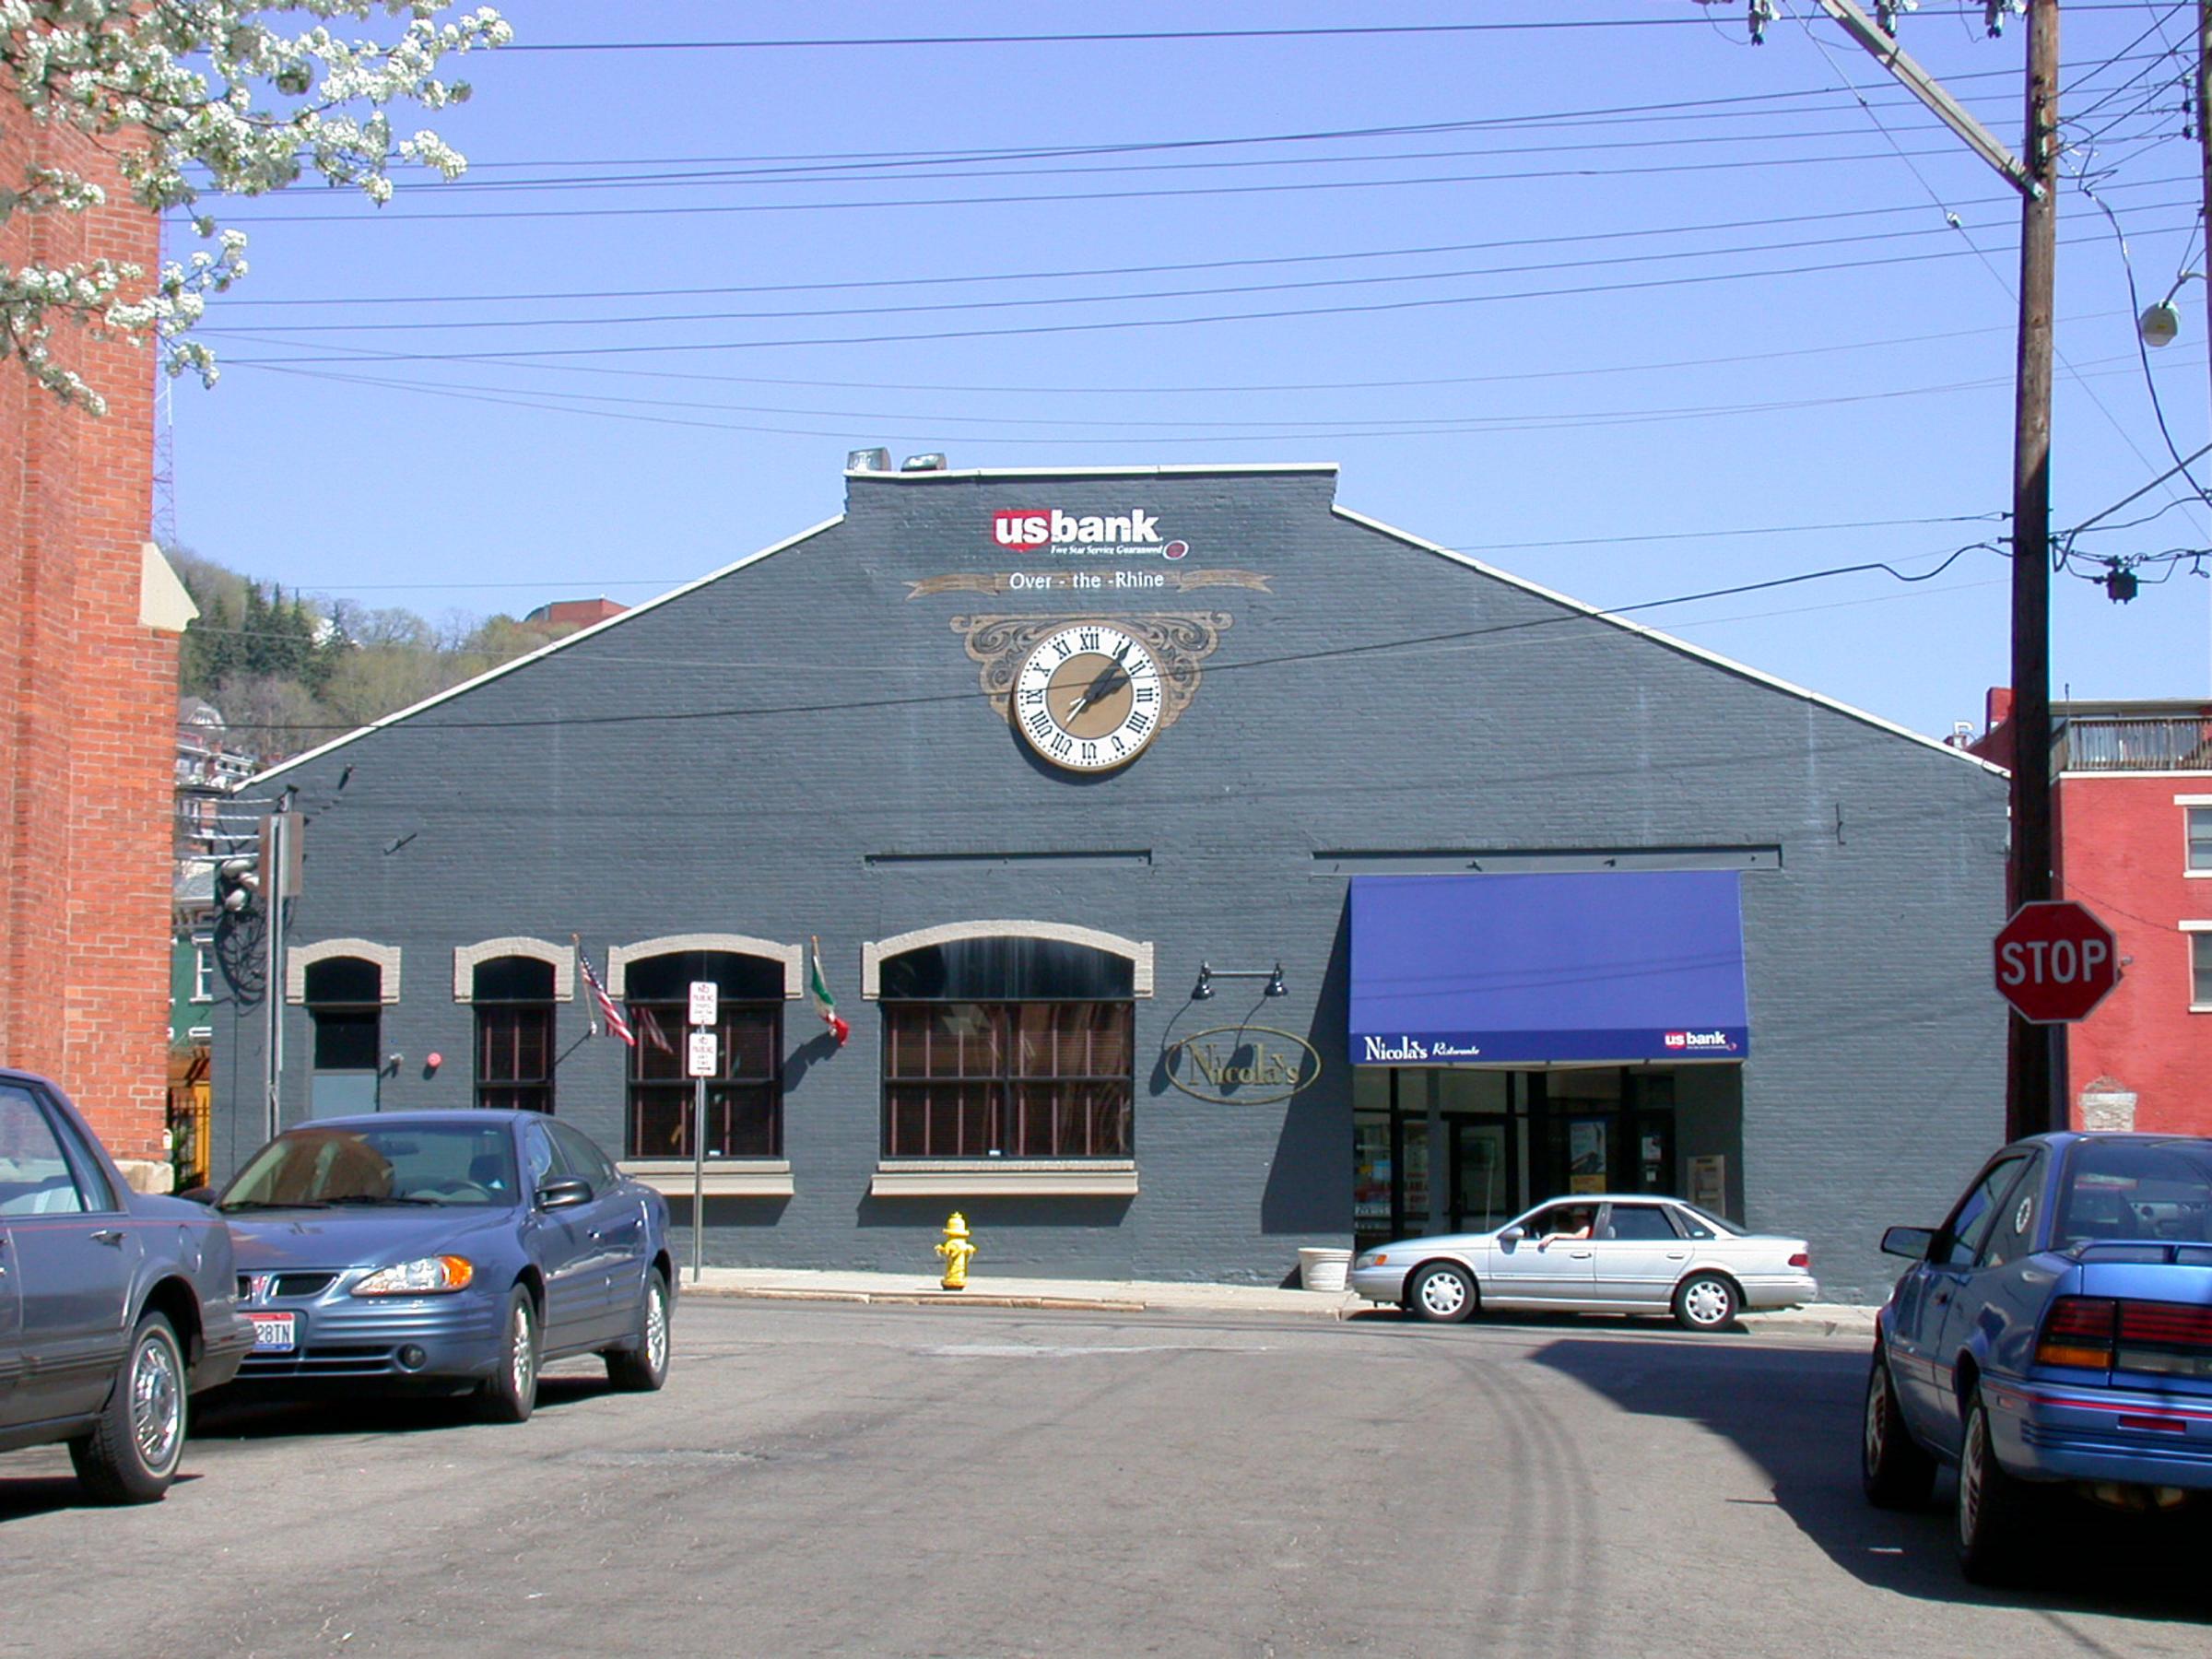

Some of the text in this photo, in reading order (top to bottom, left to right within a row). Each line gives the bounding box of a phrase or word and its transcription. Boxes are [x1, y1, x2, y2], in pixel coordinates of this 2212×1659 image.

[1069, 546, 1086, 554] Star
[1088, 545, 1114, 554] Service
[2001, 939, 2107, 986] STOP
[1186, 1043, 1300, 1086] Nicola's
[1364, 1035, 1428, 1061] Nicola's
